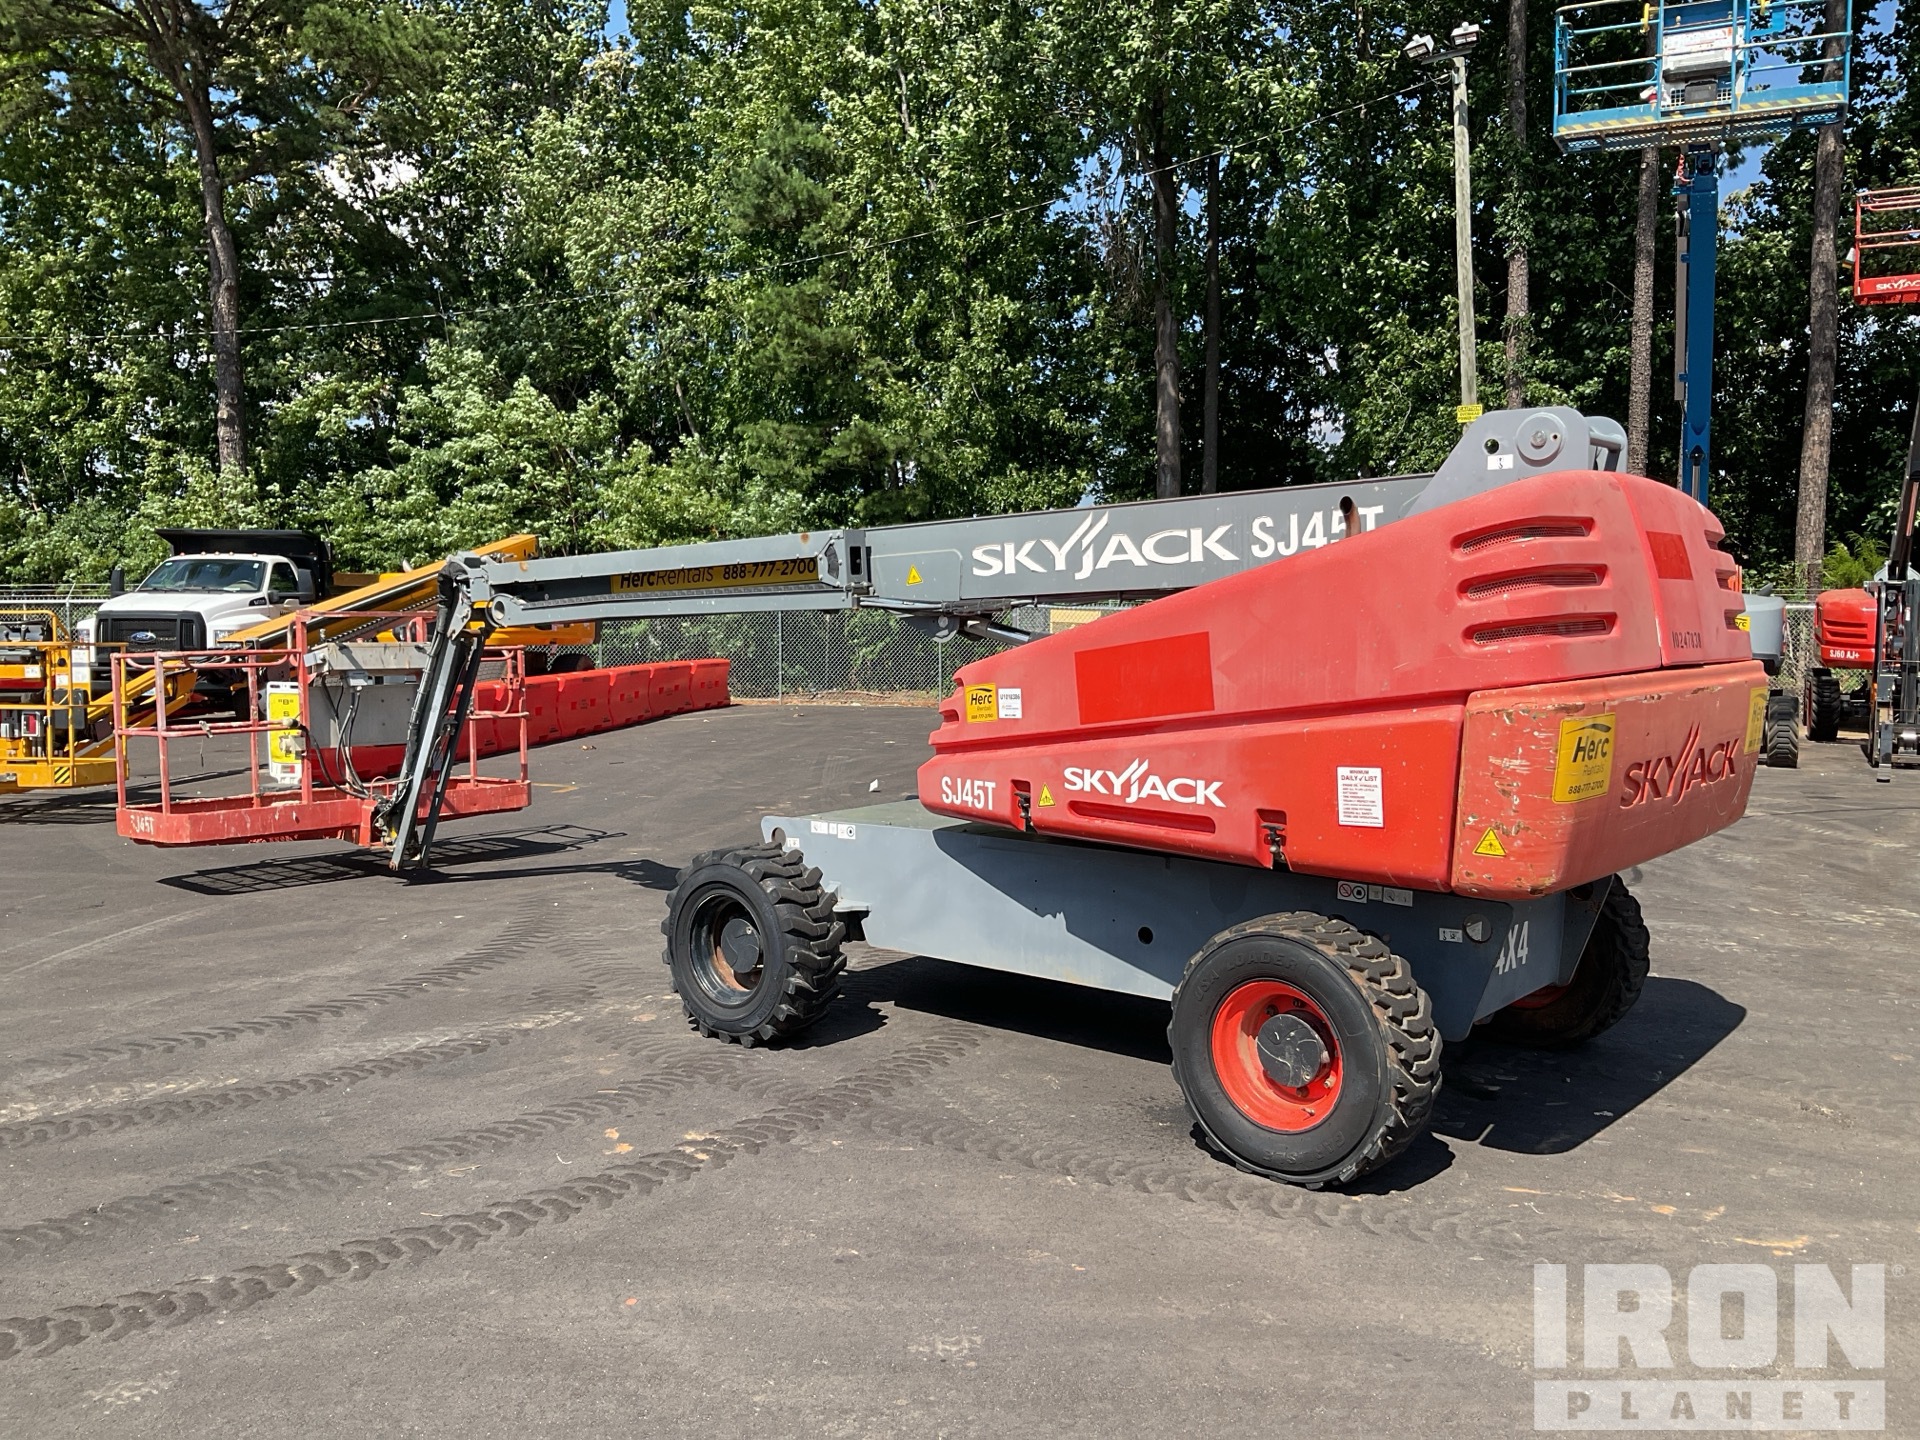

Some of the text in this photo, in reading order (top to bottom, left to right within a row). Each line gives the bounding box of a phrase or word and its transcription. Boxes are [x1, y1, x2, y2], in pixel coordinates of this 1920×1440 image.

[1876, 279, 1920, 290] SKYJAC
[971, 511, 1240, 581] SKYJACK
[620, 557, 816, 589] HercRentals 888-777-2700
[1830, 650, 1860, 659] SJ60 AJ+
[970, 693, 993, 705] Herc
[1572, 736, 1610, 763] Herc
[1620, 721, 1740, 809] SKYJACK
[941, 776, 996, 811] SJ45T
[1063, 757, 1227, 808] SKYJACK
[1568, 780, 1605, 795] 888-777-2700
